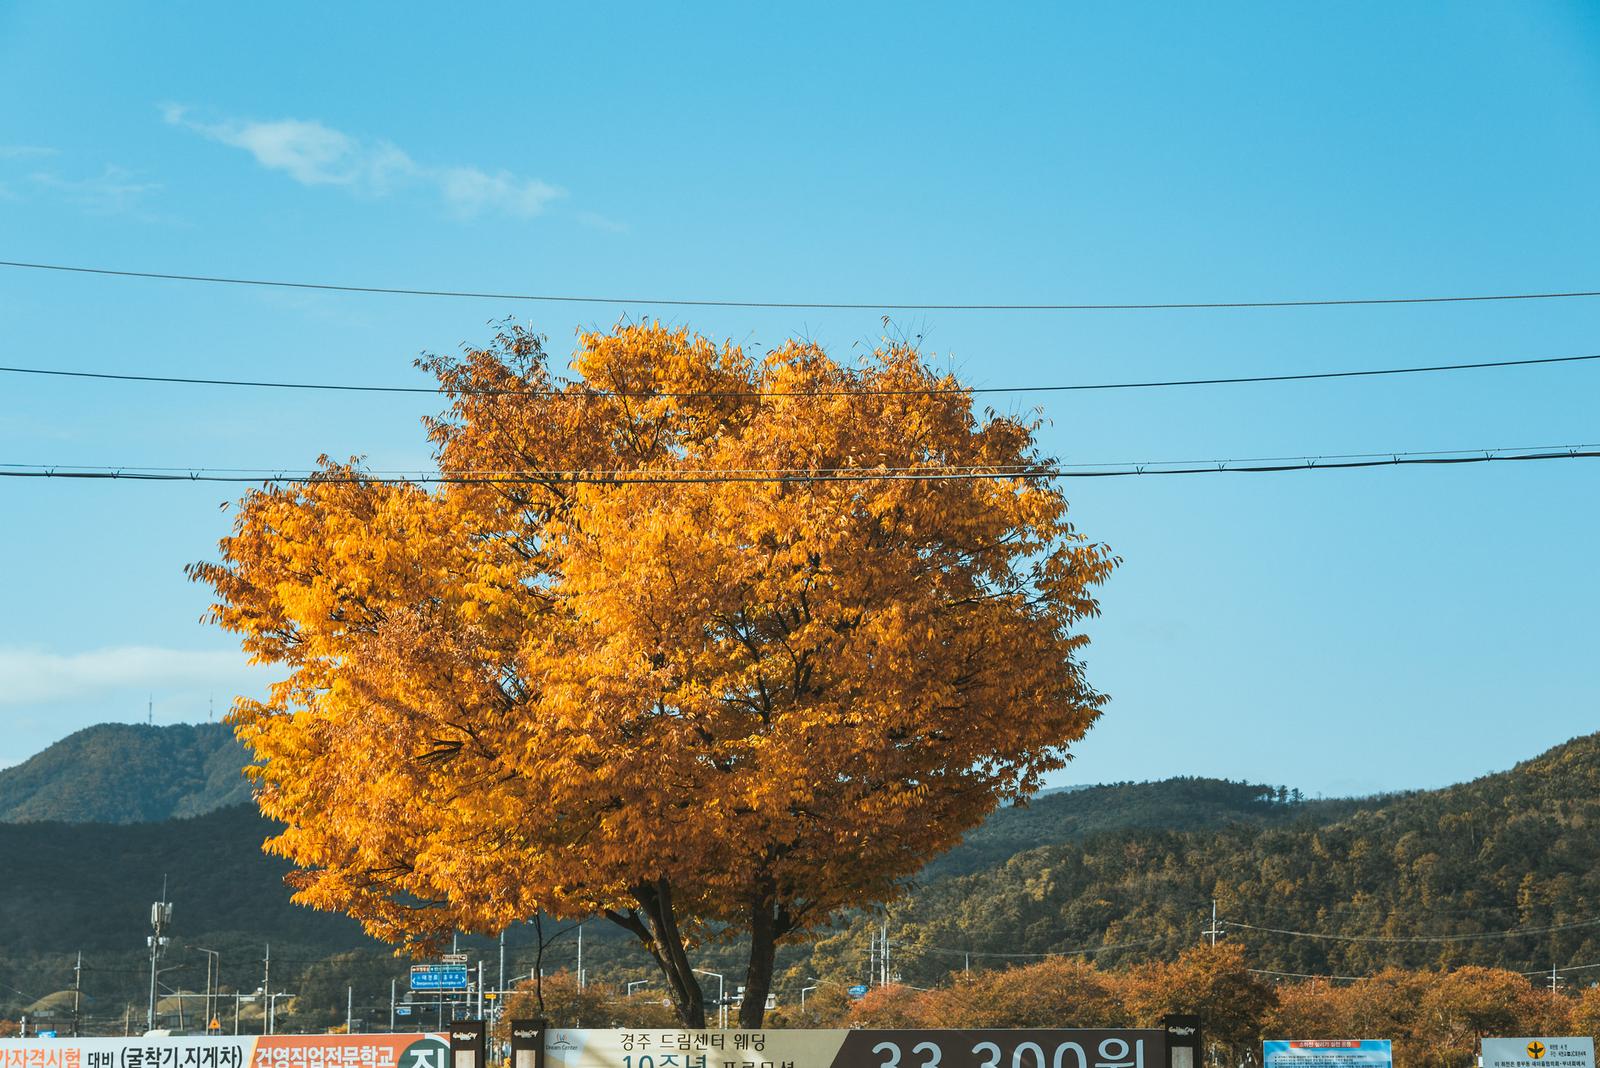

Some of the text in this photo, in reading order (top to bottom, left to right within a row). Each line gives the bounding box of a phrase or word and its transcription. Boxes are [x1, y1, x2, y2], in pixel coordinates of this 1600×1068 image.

[620, 1033, 766, 1051] 경주 드림센터 웨딩
[87, 1051, 114, 1068] 대비
[255, 1046, 396, 1068] 건영직업전문학교
